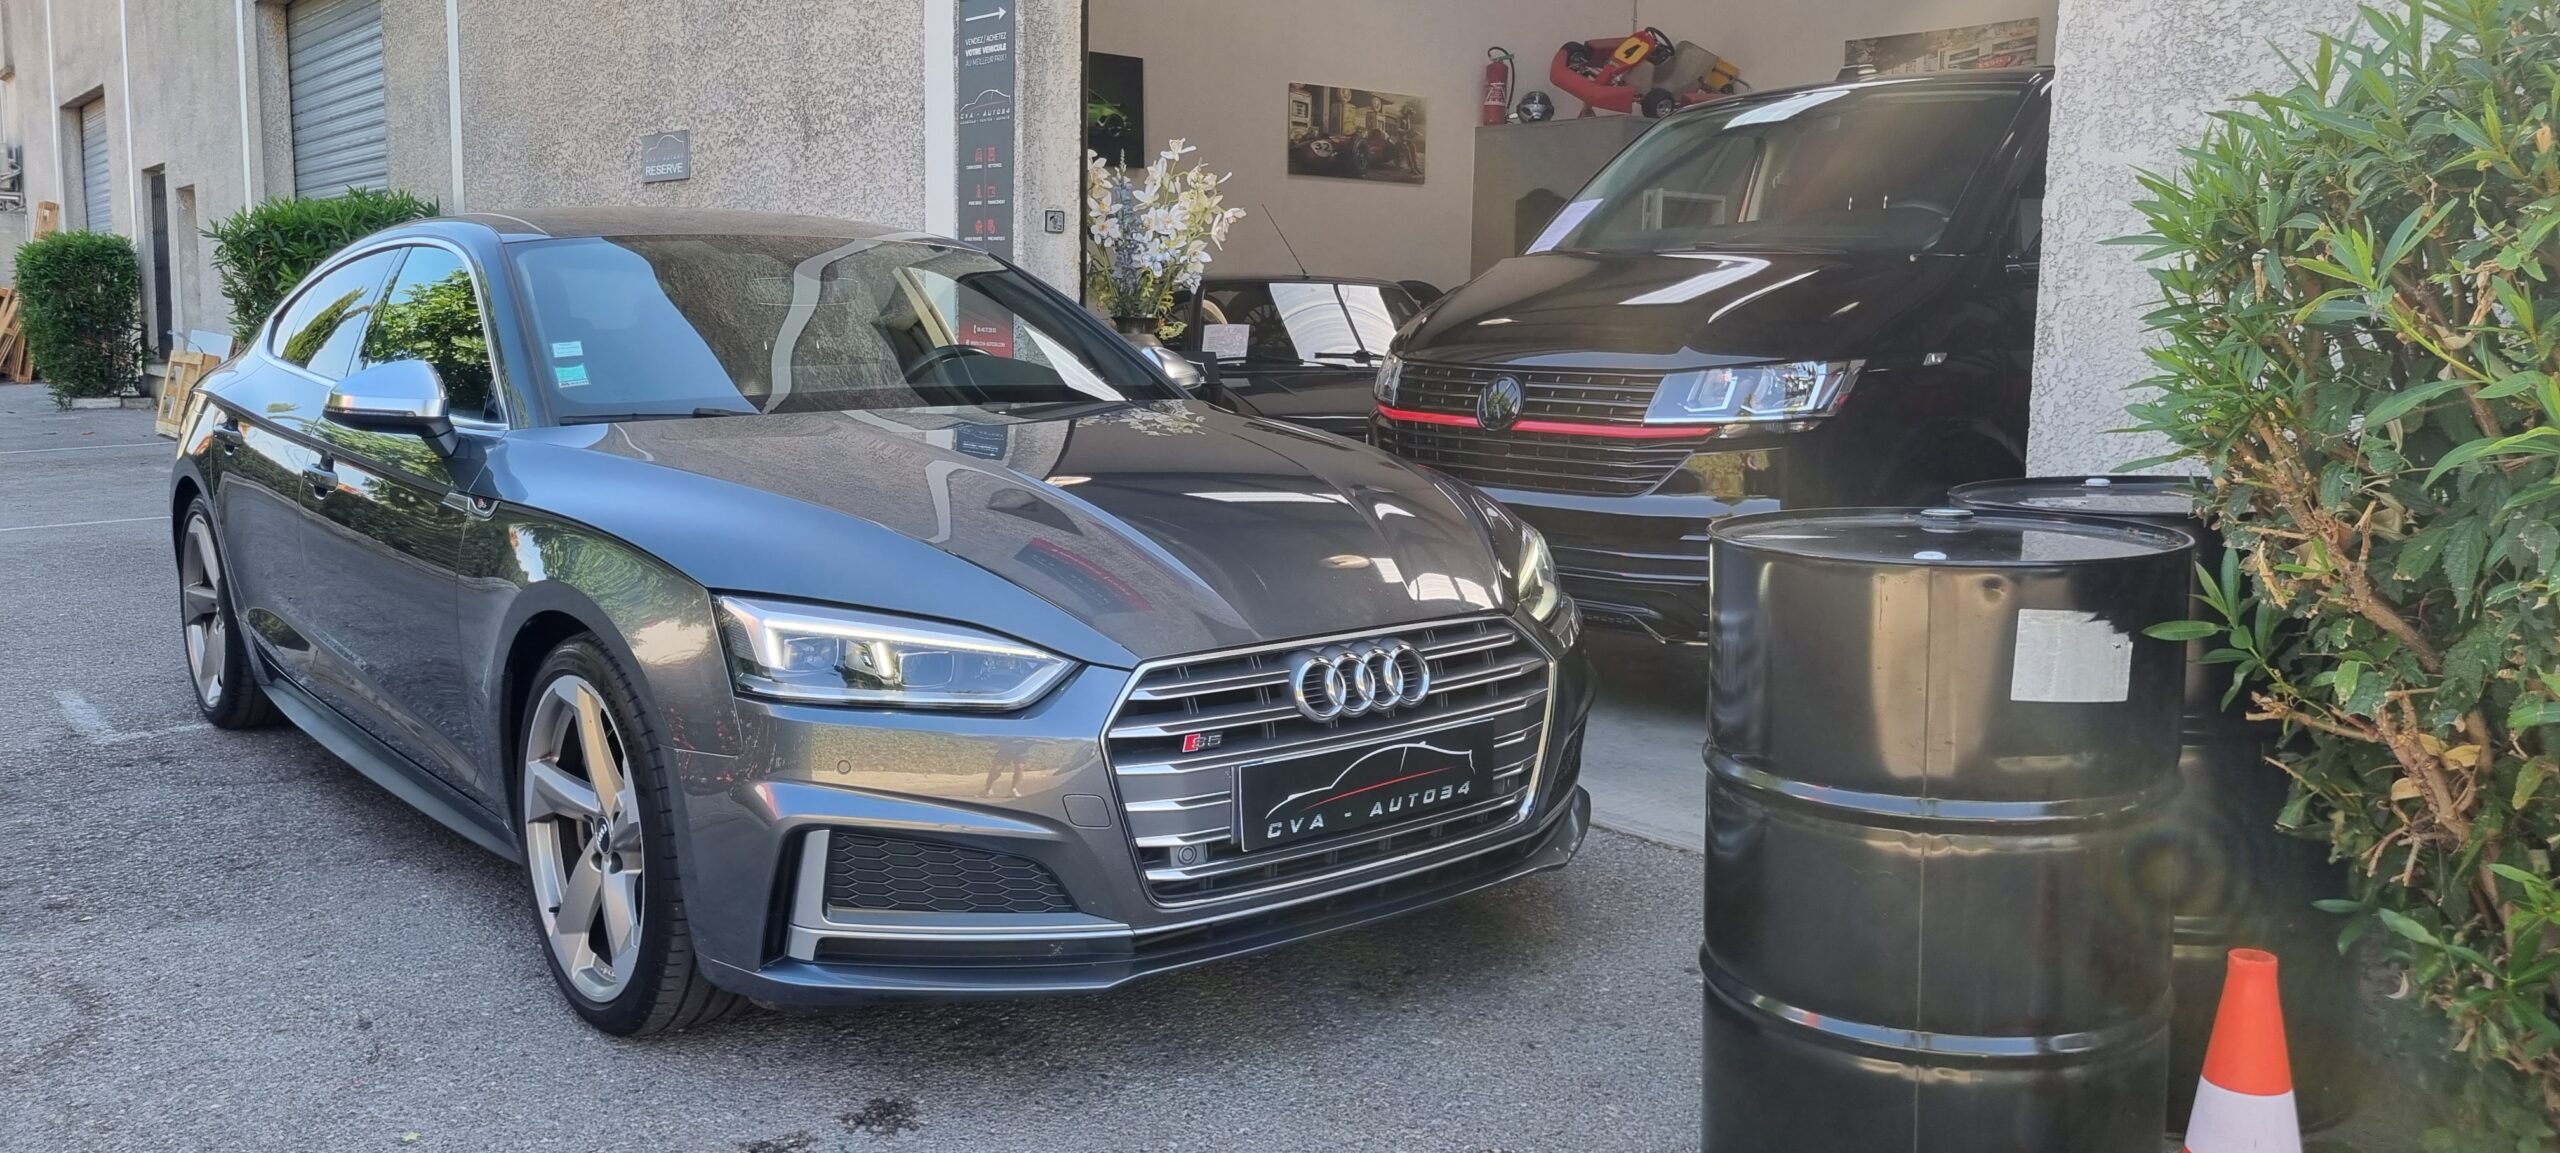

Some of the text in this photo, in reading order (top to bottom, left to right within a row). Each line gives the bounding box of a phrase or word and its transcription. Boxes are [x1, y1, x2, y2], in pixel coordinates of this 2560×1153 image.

[1314, 142, 1331, 152] 32
[645, 162, 683, 176] RESERVE
[1267, 814, 1324, 838] CVA
[1369, 781, 1471, 817] AUTO34
